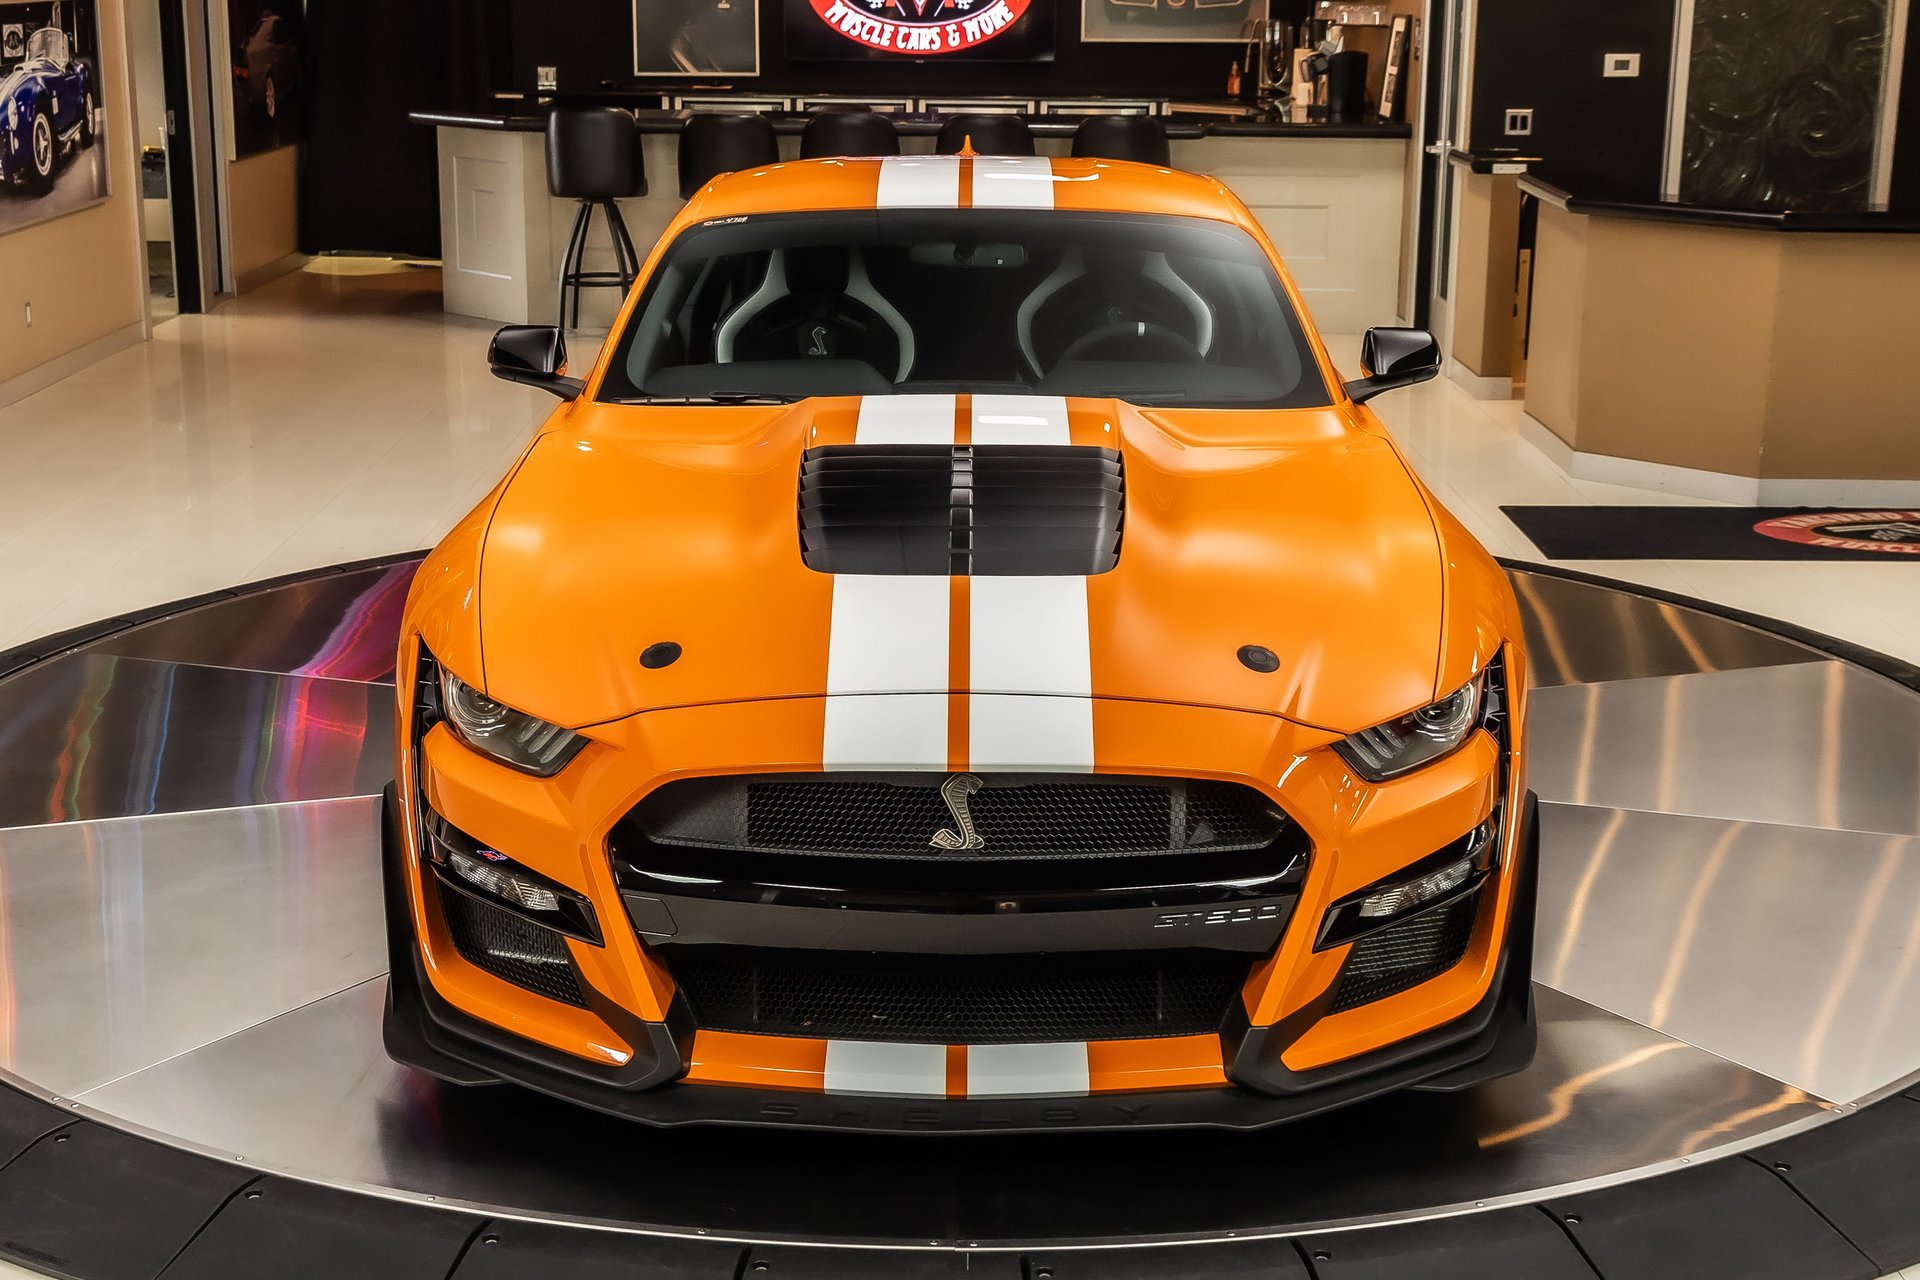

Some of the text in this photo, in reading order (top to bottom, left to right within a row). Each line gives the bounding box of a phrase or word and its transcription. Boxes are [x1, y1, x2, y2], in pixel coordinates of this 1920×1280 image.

[824, 1, 1014, 50] MUSCLE CARS & MORE
[759, 1101, 1152, 1124] SHELBY
